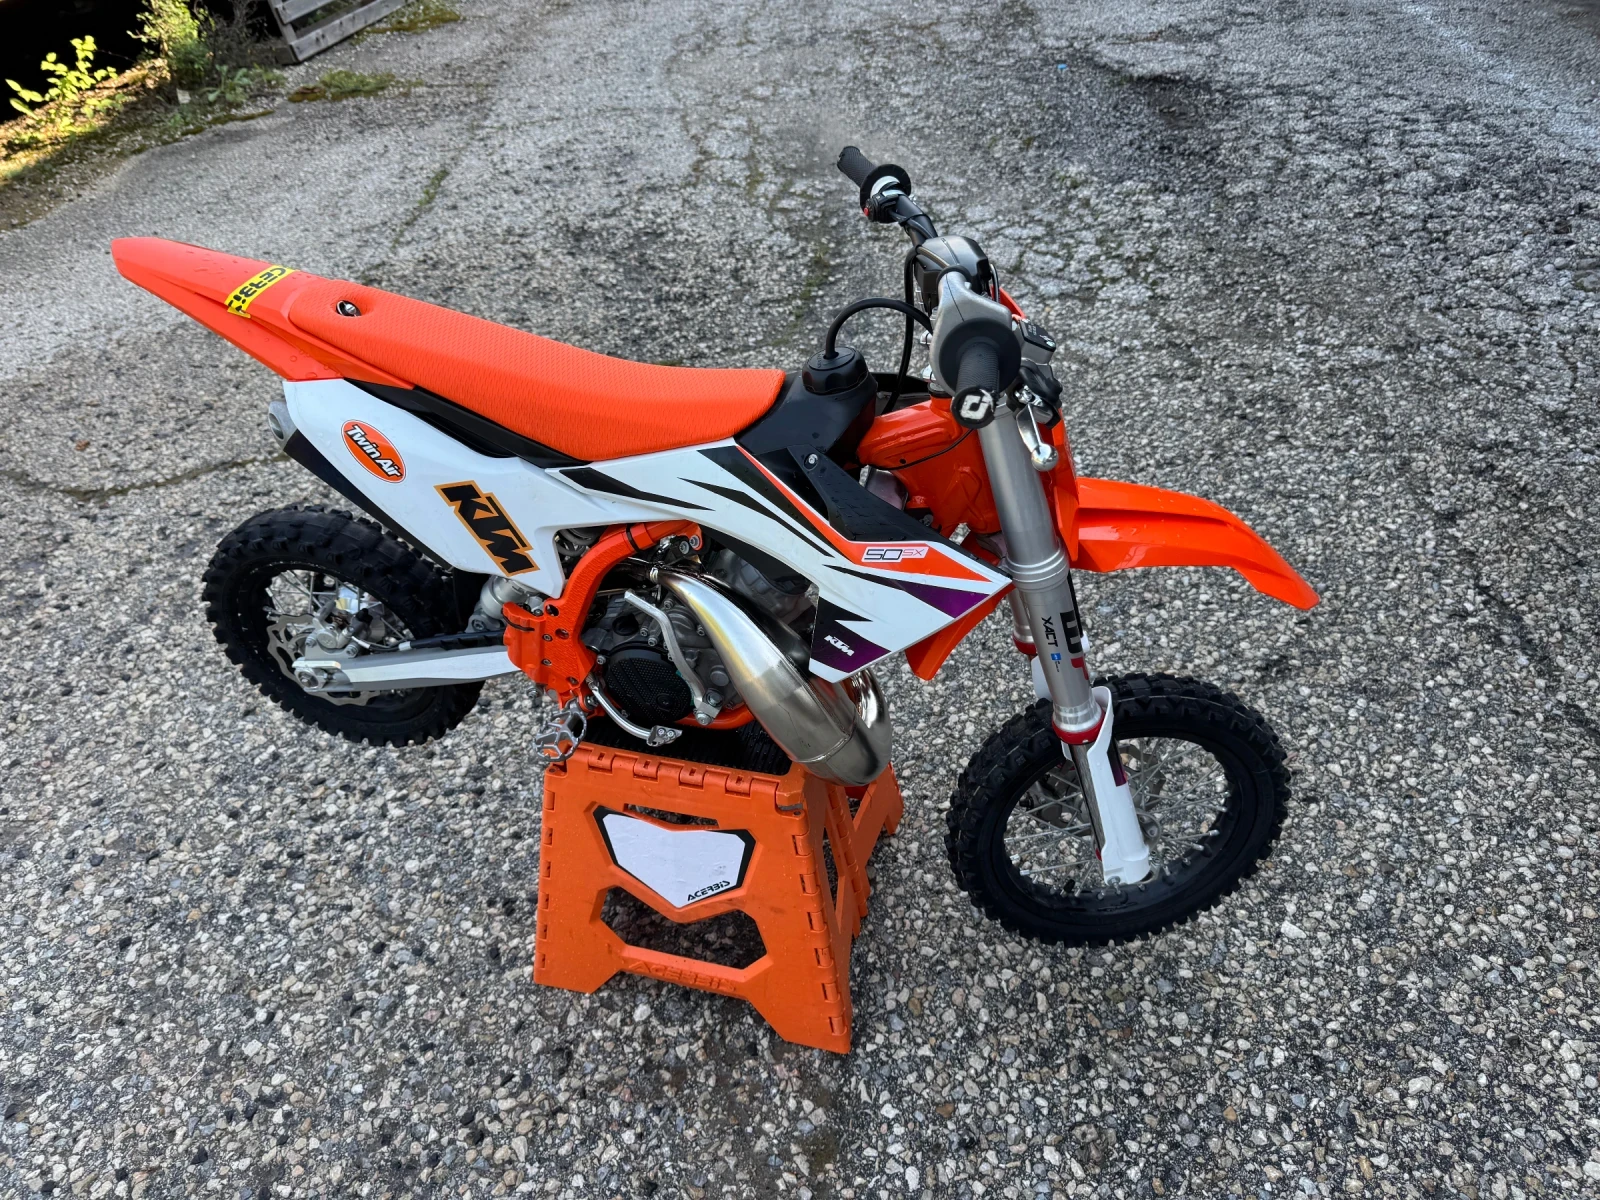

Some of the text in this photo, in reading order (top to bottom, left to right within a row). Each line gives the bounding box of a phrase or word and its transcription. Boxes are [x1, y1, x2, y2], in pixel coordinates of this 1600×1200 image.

[345, 424, 402, 477] Twin Air
[437, 482, 537, 575] KTM
[823, 635, 855, 657] KTM
[1041, 616, 1058, 647] XACT
